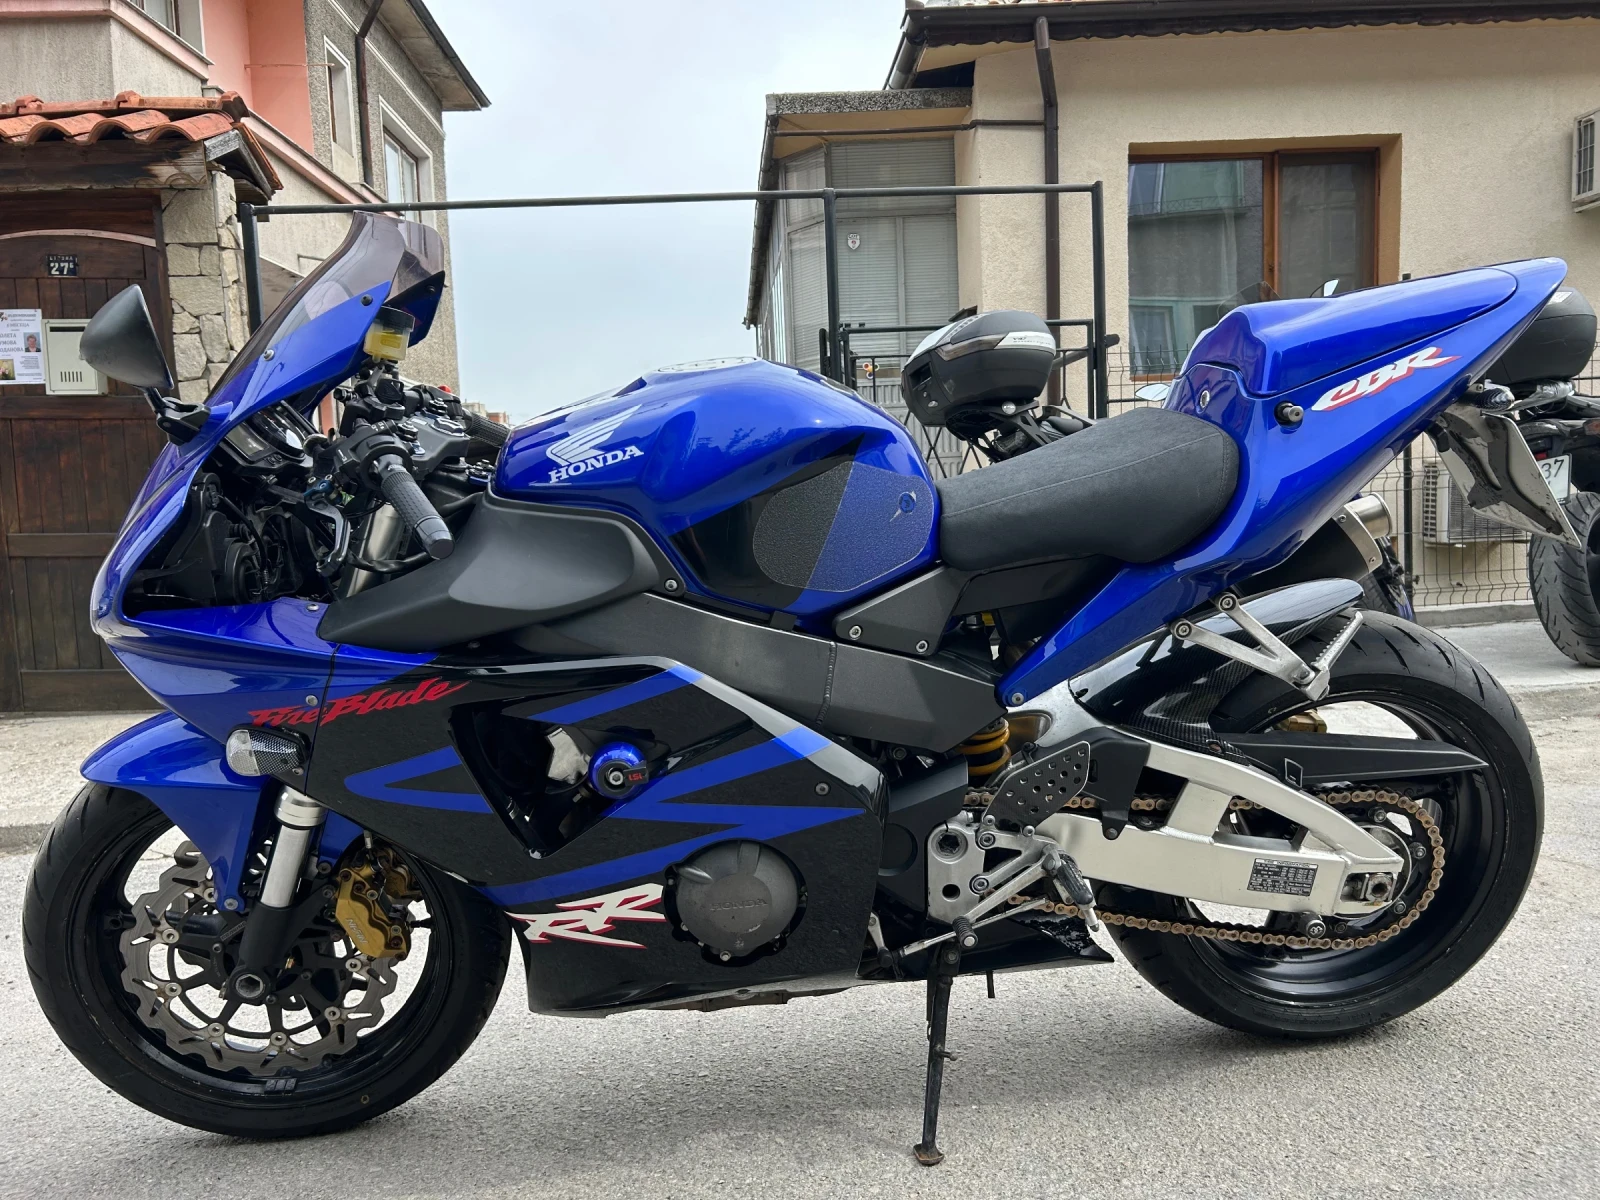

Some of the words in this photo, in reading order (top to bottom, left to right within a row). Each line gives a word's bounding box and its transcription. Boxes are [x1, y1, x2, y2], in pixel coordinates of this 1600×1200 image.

[1311, 346, 1462, 411] CBR
[548, 445, 644, 483] HONDA
[504, 883, 669, 949] RR
[710, 898, 769, 911] HONDA
